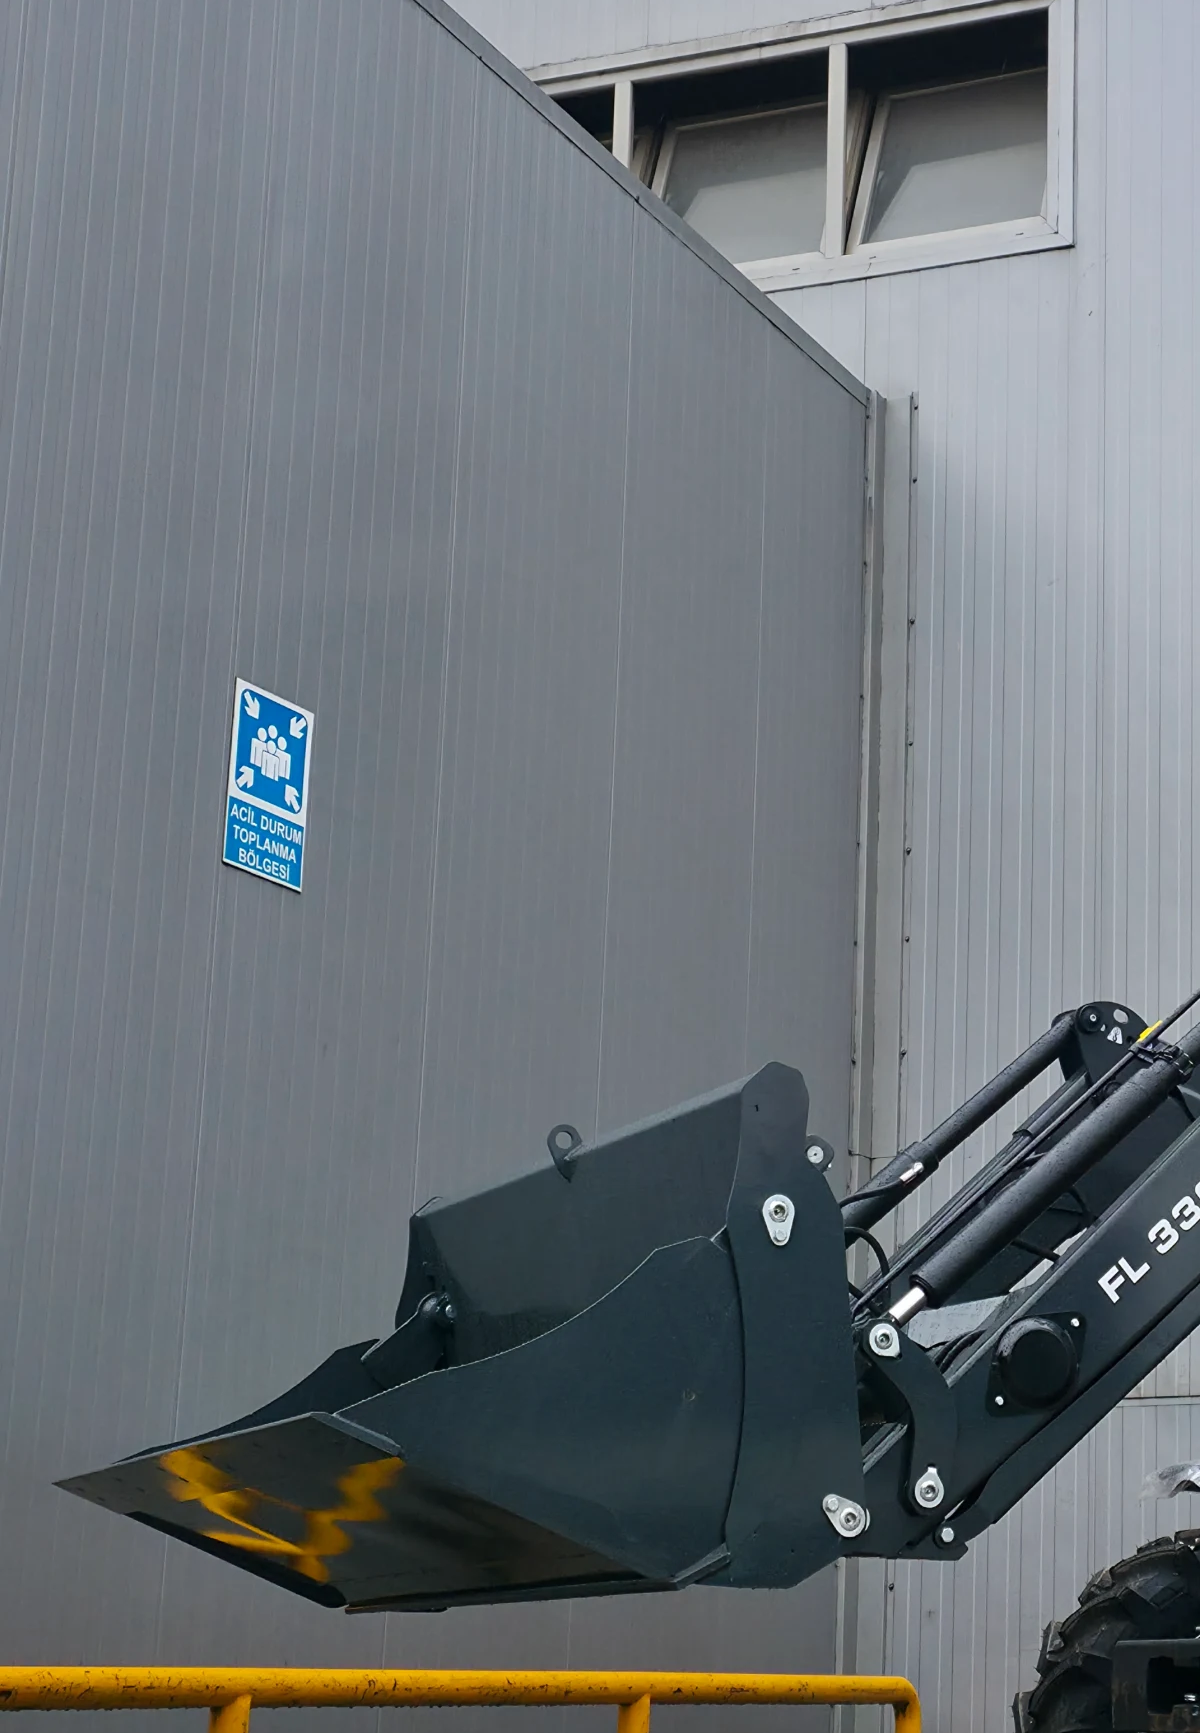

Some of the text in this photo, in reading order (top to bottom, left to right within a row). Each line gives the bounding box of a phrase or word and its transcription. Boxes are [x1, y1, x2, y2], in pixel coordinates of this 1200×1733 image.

[230, 803, 302, 846] ACİL DURUM
[233, 824, 296, 864] TOPLANMA
[238, 848, 290, 881] BÖLGESİ
[1098, 1256, 1150, 1304] FL
